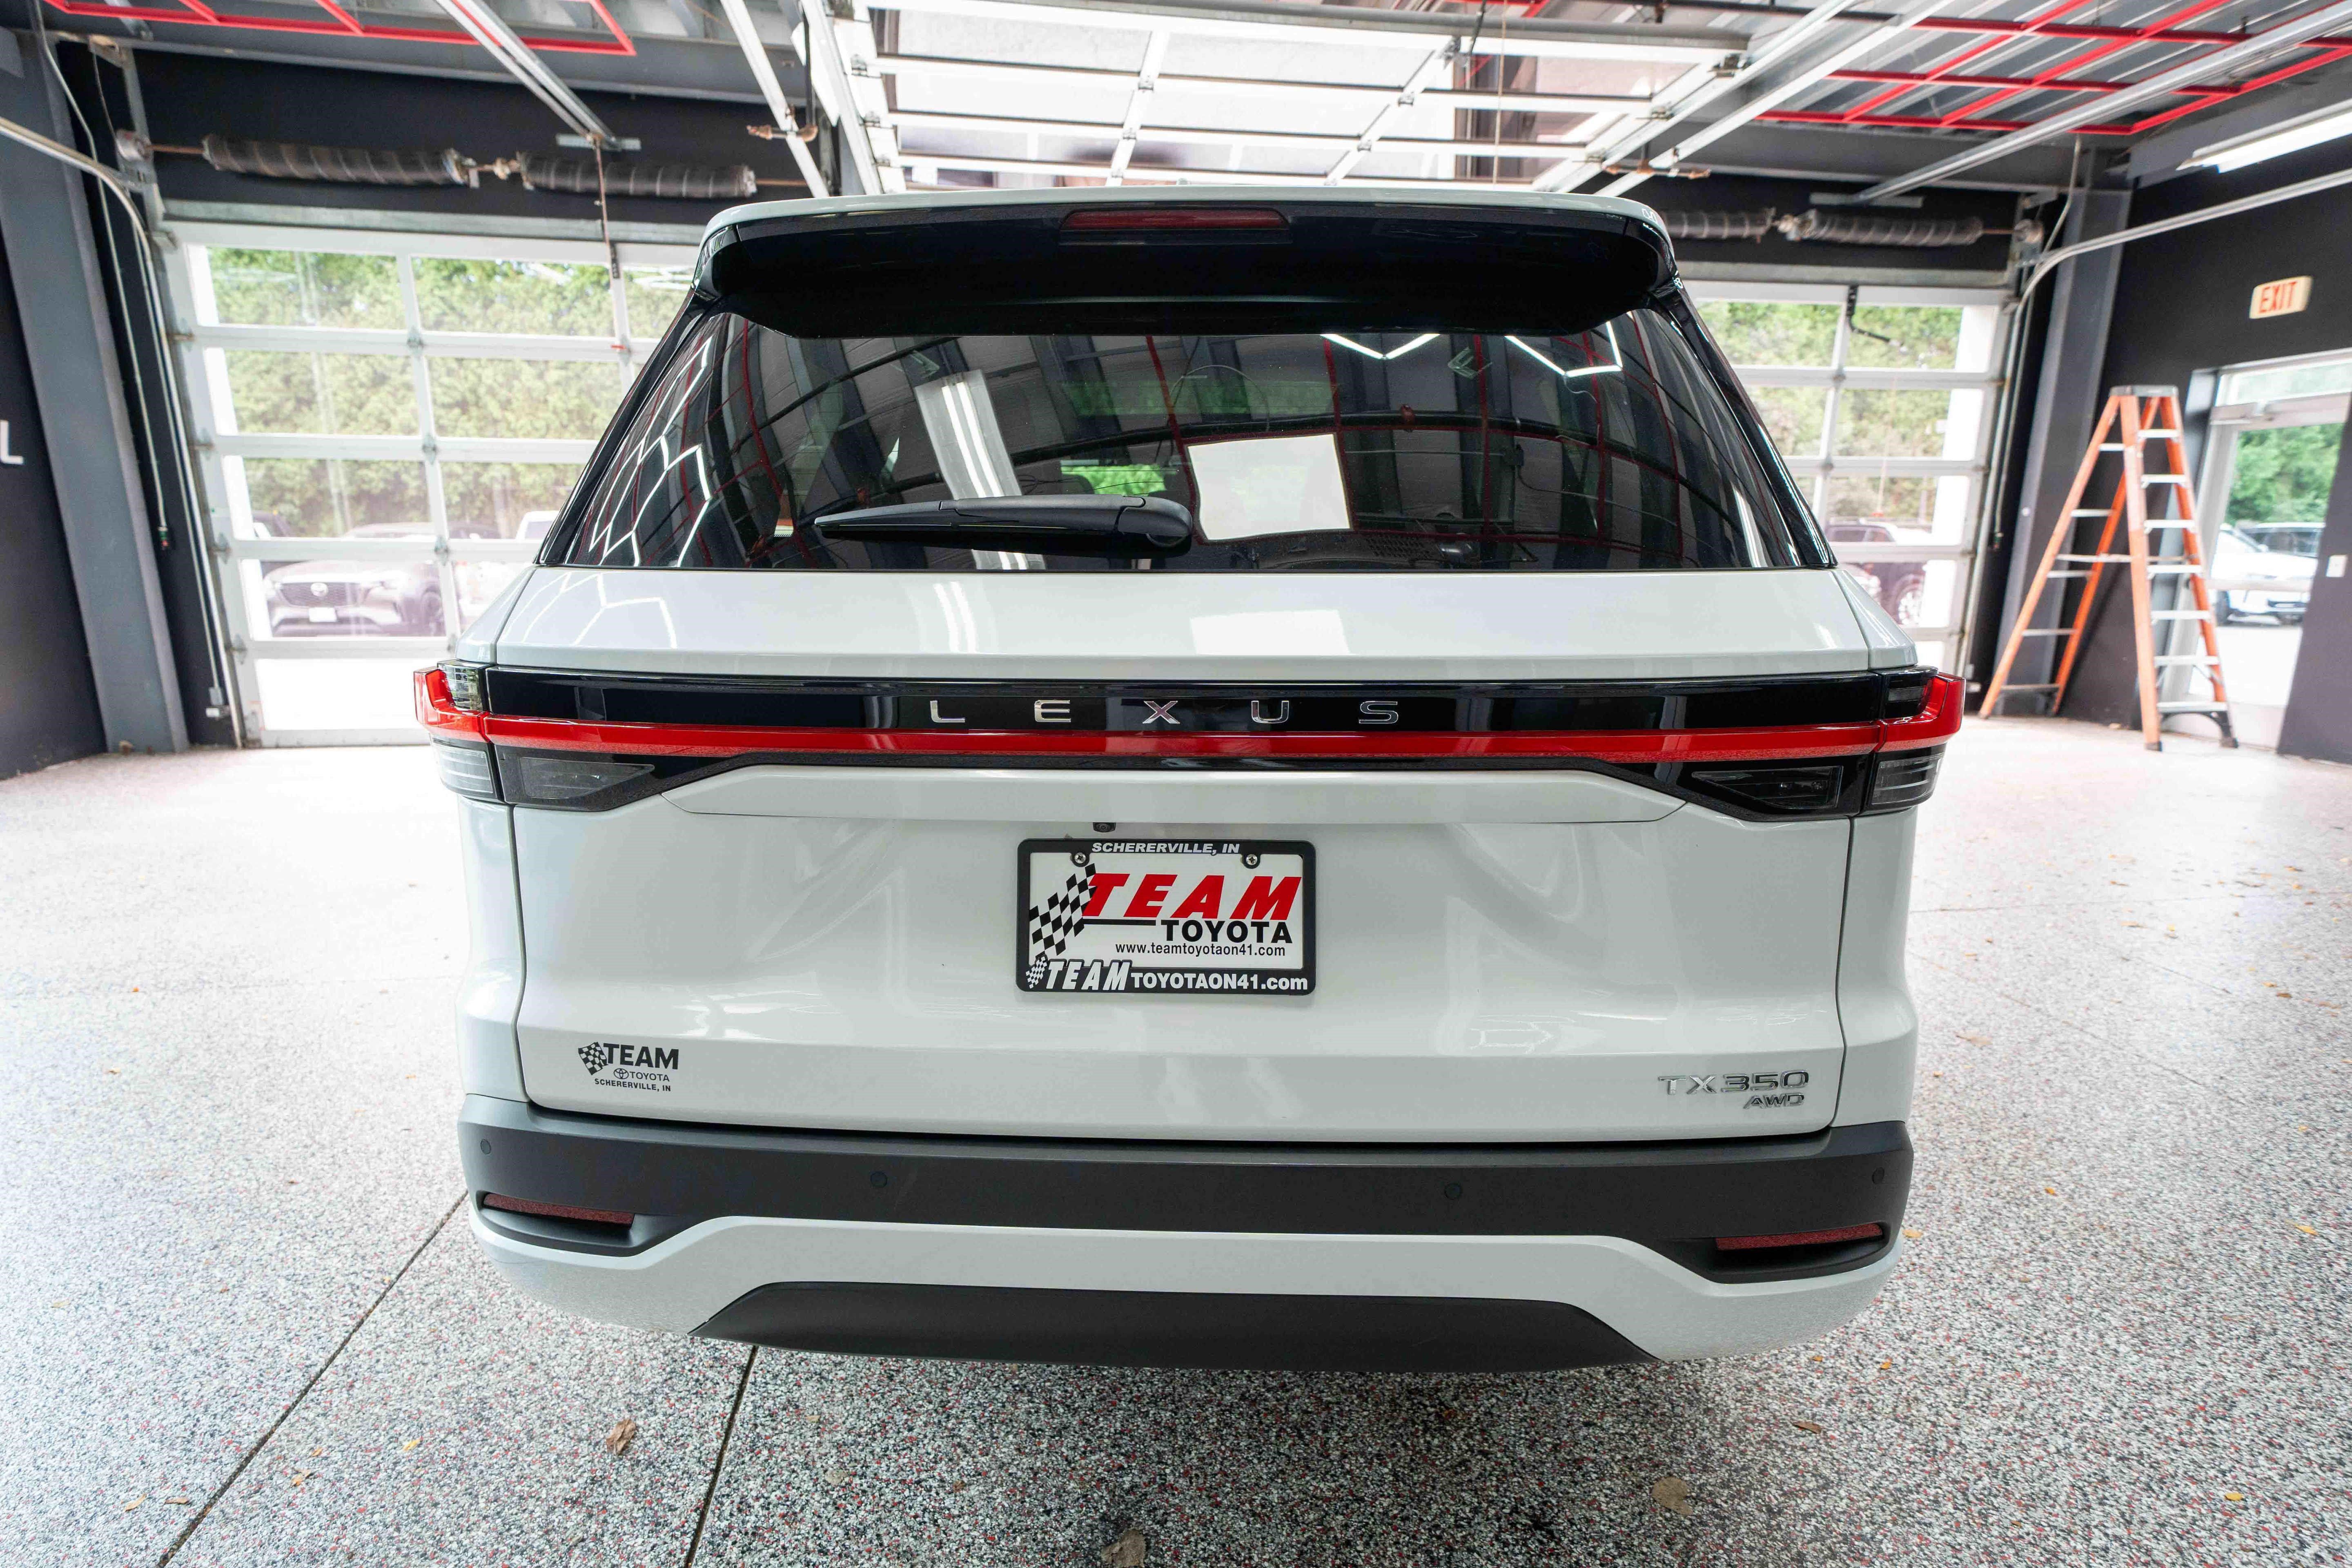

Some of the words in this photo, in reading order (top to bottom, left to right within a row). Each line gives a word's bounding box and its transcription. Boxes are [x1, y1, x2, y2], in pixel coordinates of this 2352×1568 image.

[2258, 281, 2297, 314] EXIT
[930, 699, 1399, 724] LEXUS
[1091, 842, 1217, 856] SCHERERVILLE,
[1222, 844, 1240, 853] IN
[1082, 873, 1302, 920] TEAM
[1160, 919, 1293, 944] TOYOTA
[1115, 942, 1285, 957] www.teamtoyotaon41.com
[1045, 961, 1132, 991] TEAM
[1131, 972, 1307, 990] TOYOTAON41.com
[603, 1042, 679, 1070] TEAM
[595, 1078, 660, 1091] SCHERERVILLE,
[629, 1071, 670, 1082] TOYOTA
[1743, 1092, 1805, 1109] AWD
